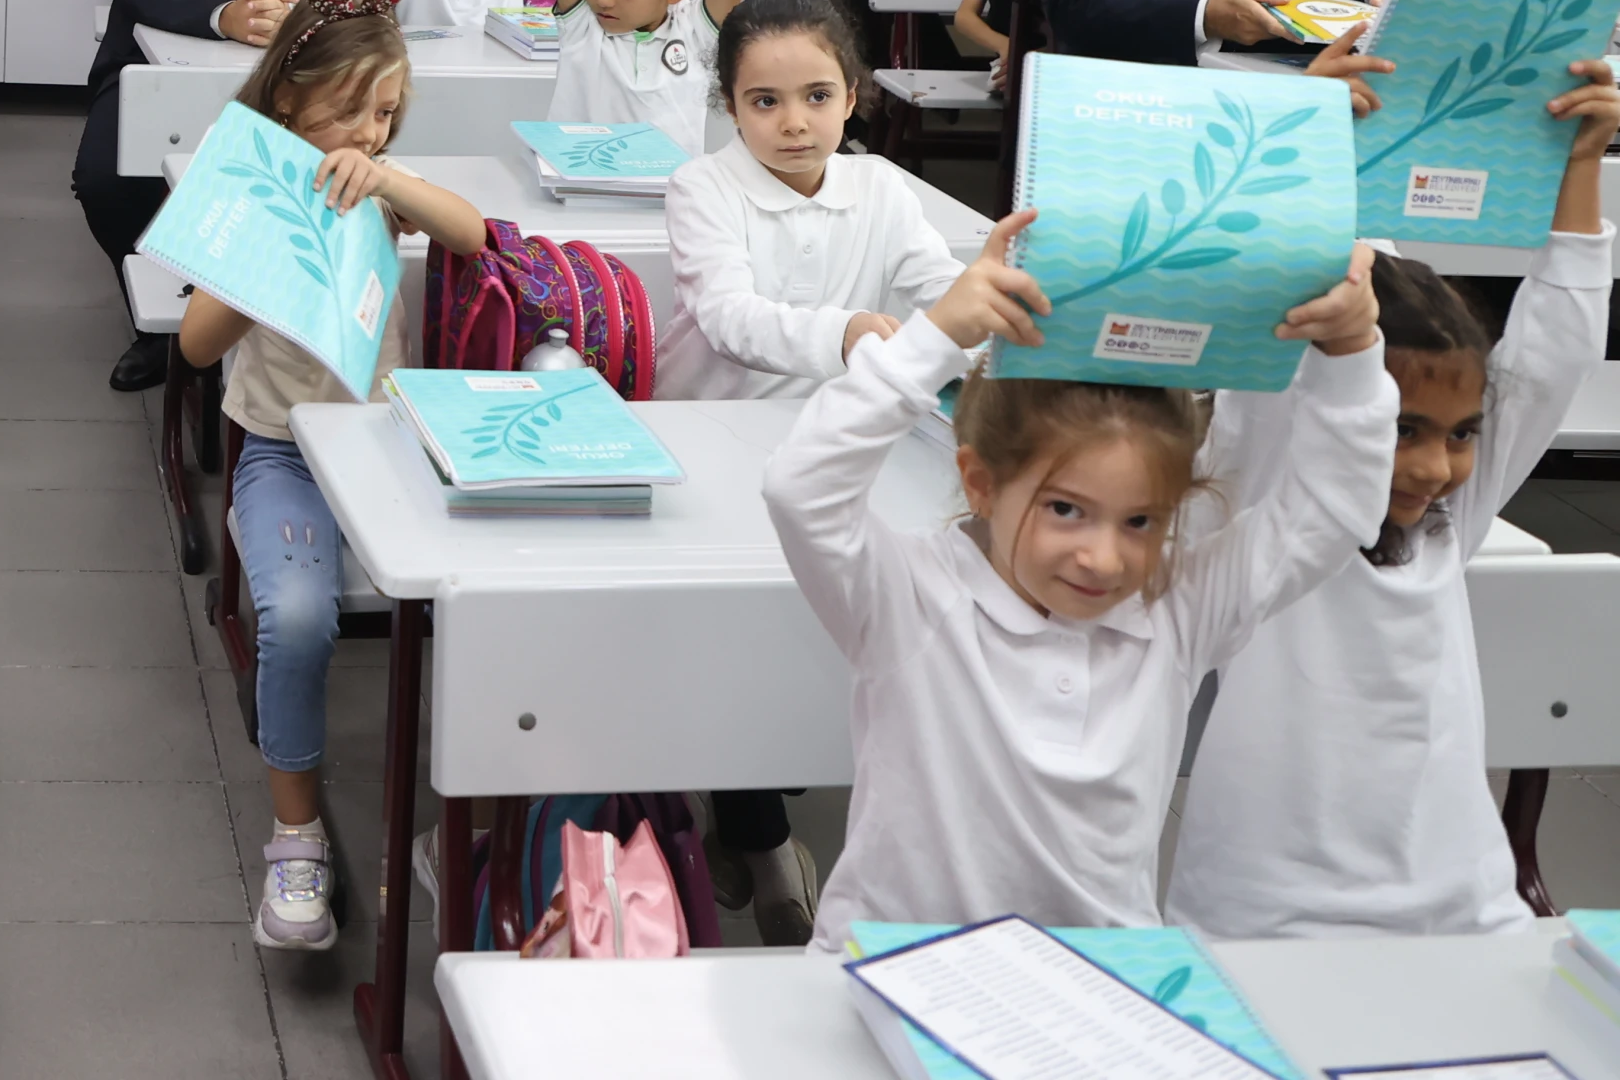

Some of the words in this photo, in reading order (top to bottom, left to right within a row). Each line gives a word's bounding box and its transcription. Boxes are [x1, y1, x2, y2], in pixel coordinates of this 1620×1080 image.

[1093, 88, 1174, 109] OKUL
[1074, 103, 1194, 130] DEFTERİ
[197, 198, 228, 238] OKUL
[207, 196, 253, 259] DEFTERİ
[569, 451, 626, 460] OKUL
